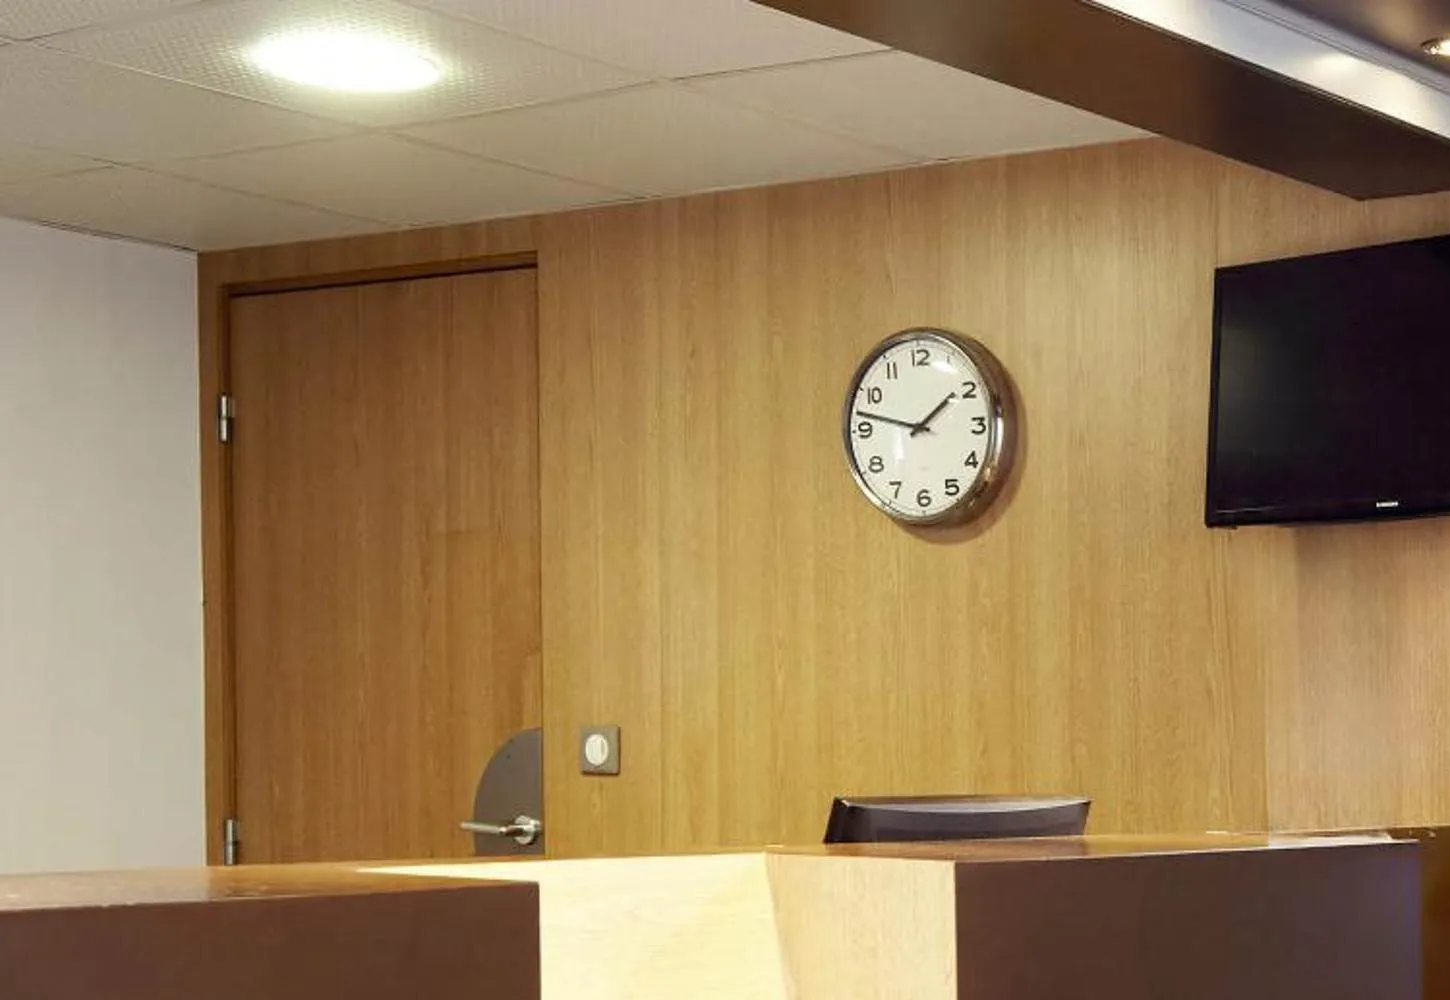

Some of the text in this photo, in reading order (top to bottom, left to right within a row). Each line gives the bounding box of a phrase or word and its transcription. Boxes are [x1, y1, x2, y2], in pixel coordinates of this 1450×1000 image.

[911, 349, 931, 366] 12
[886, 362, 898, 380] 11
[867, 387, 883, 404] 10
[962, 381, 977, 398] 2
[858, 421, 873, 439] 9
[971, 416, 987, 435] 3
[868, 455, 885, 473] 8
[964, 450, 979, 469] 4
[889, 480, 902, 499] 7
[944, 478, 960, 496] 5
[916, 489, 932, 507] 6
